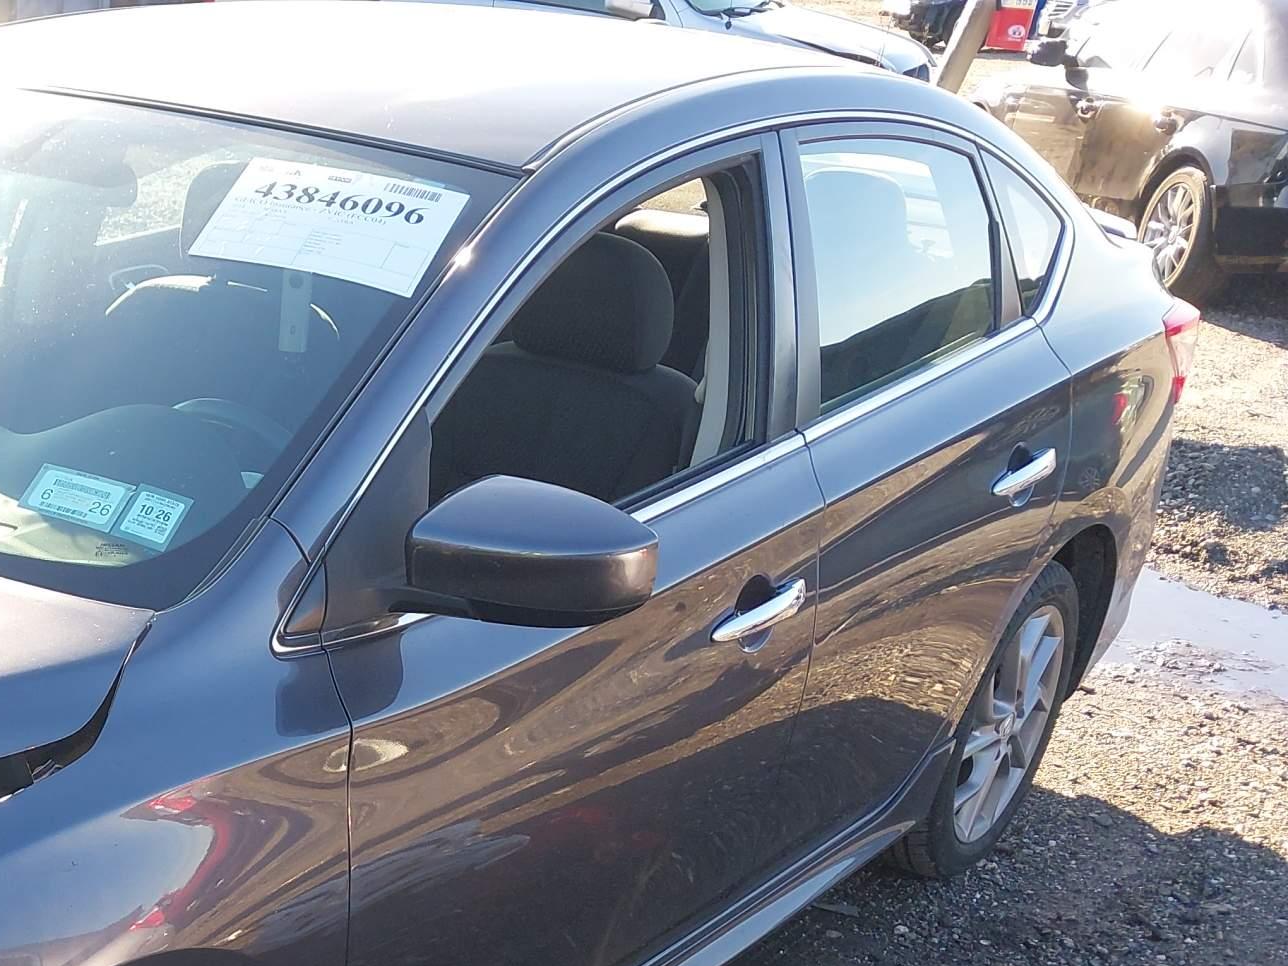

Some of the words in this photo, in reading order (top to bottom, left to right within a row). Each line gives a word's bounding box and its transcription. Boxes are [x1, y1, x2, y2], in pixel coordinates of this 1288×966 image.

[254, 181, 430, 225] 43846096
[40, 488, 54, 501] 6
[88, 501, 112, 517] 26
[139, 504, 154, 516] 10
[155, 509, 173, 522] 26
